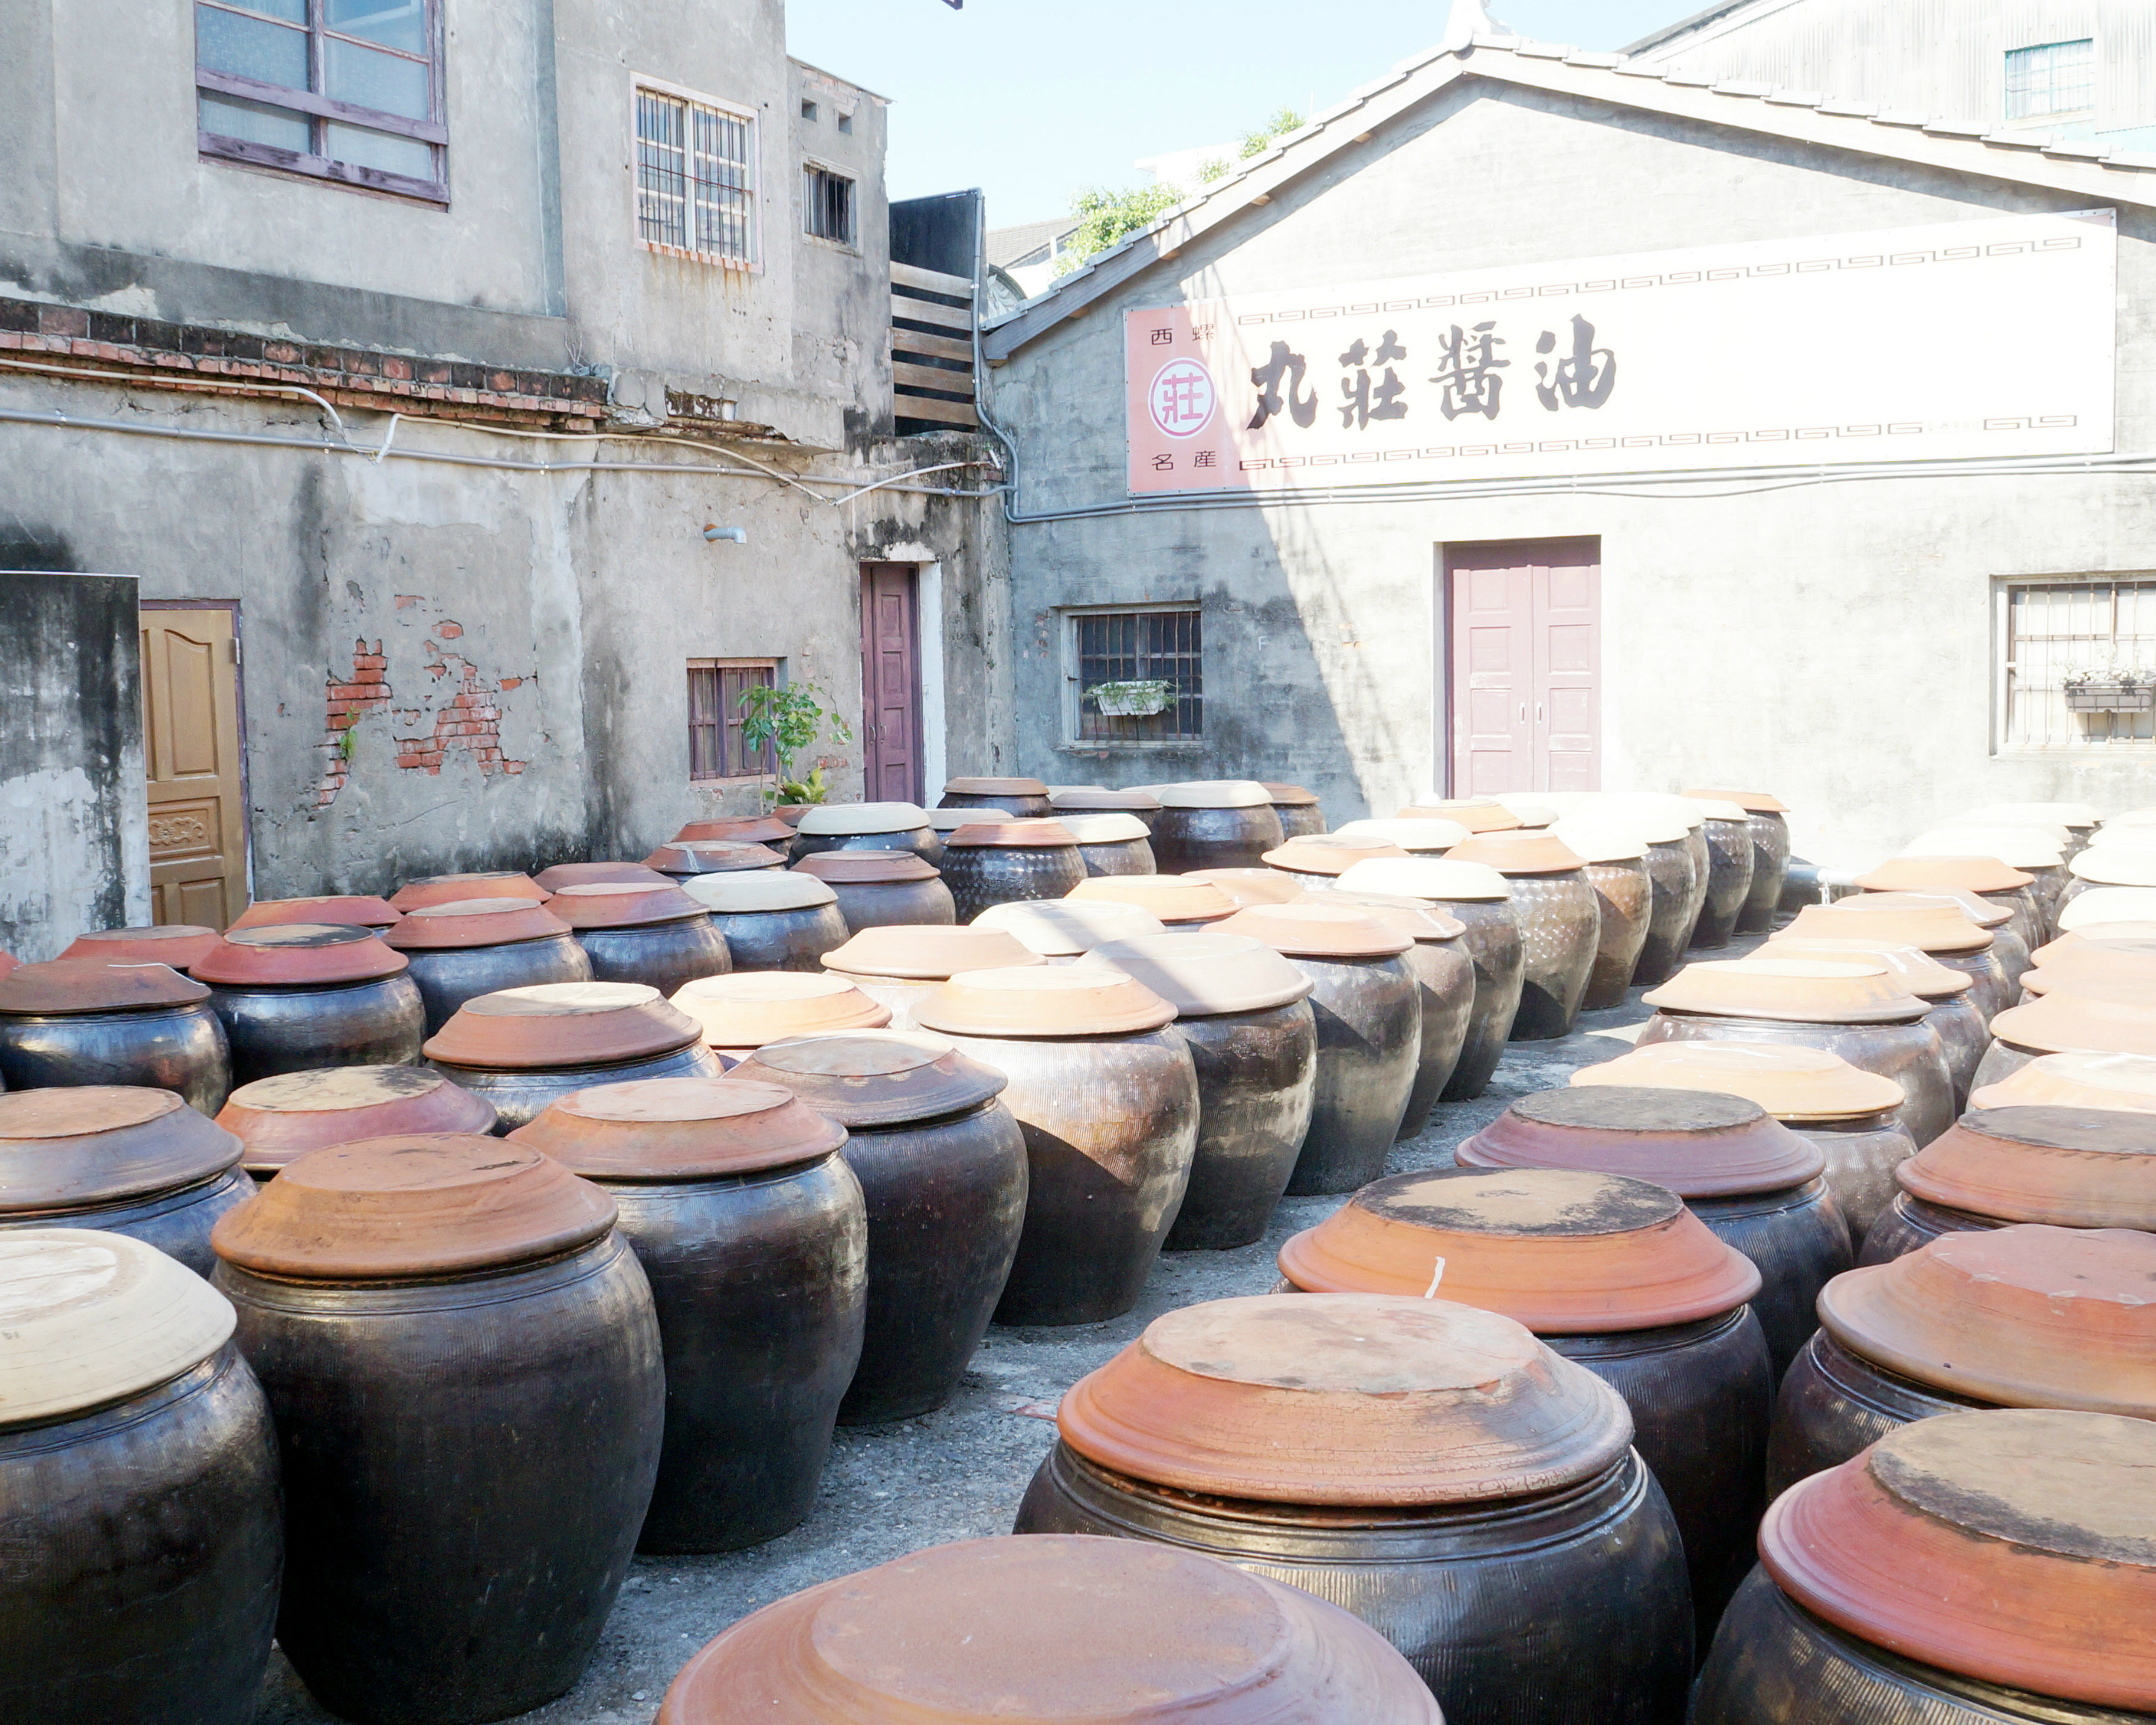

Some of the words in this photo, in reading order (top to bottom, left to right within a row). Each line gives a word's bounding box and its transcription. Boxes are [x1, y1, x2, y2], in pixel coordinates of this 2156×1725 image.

[1151, 323, 1214, 346] 西螺
[1162, 372, 1205, 424] 莊
[1246, 314, 1616, 432] 丸莊醬油
